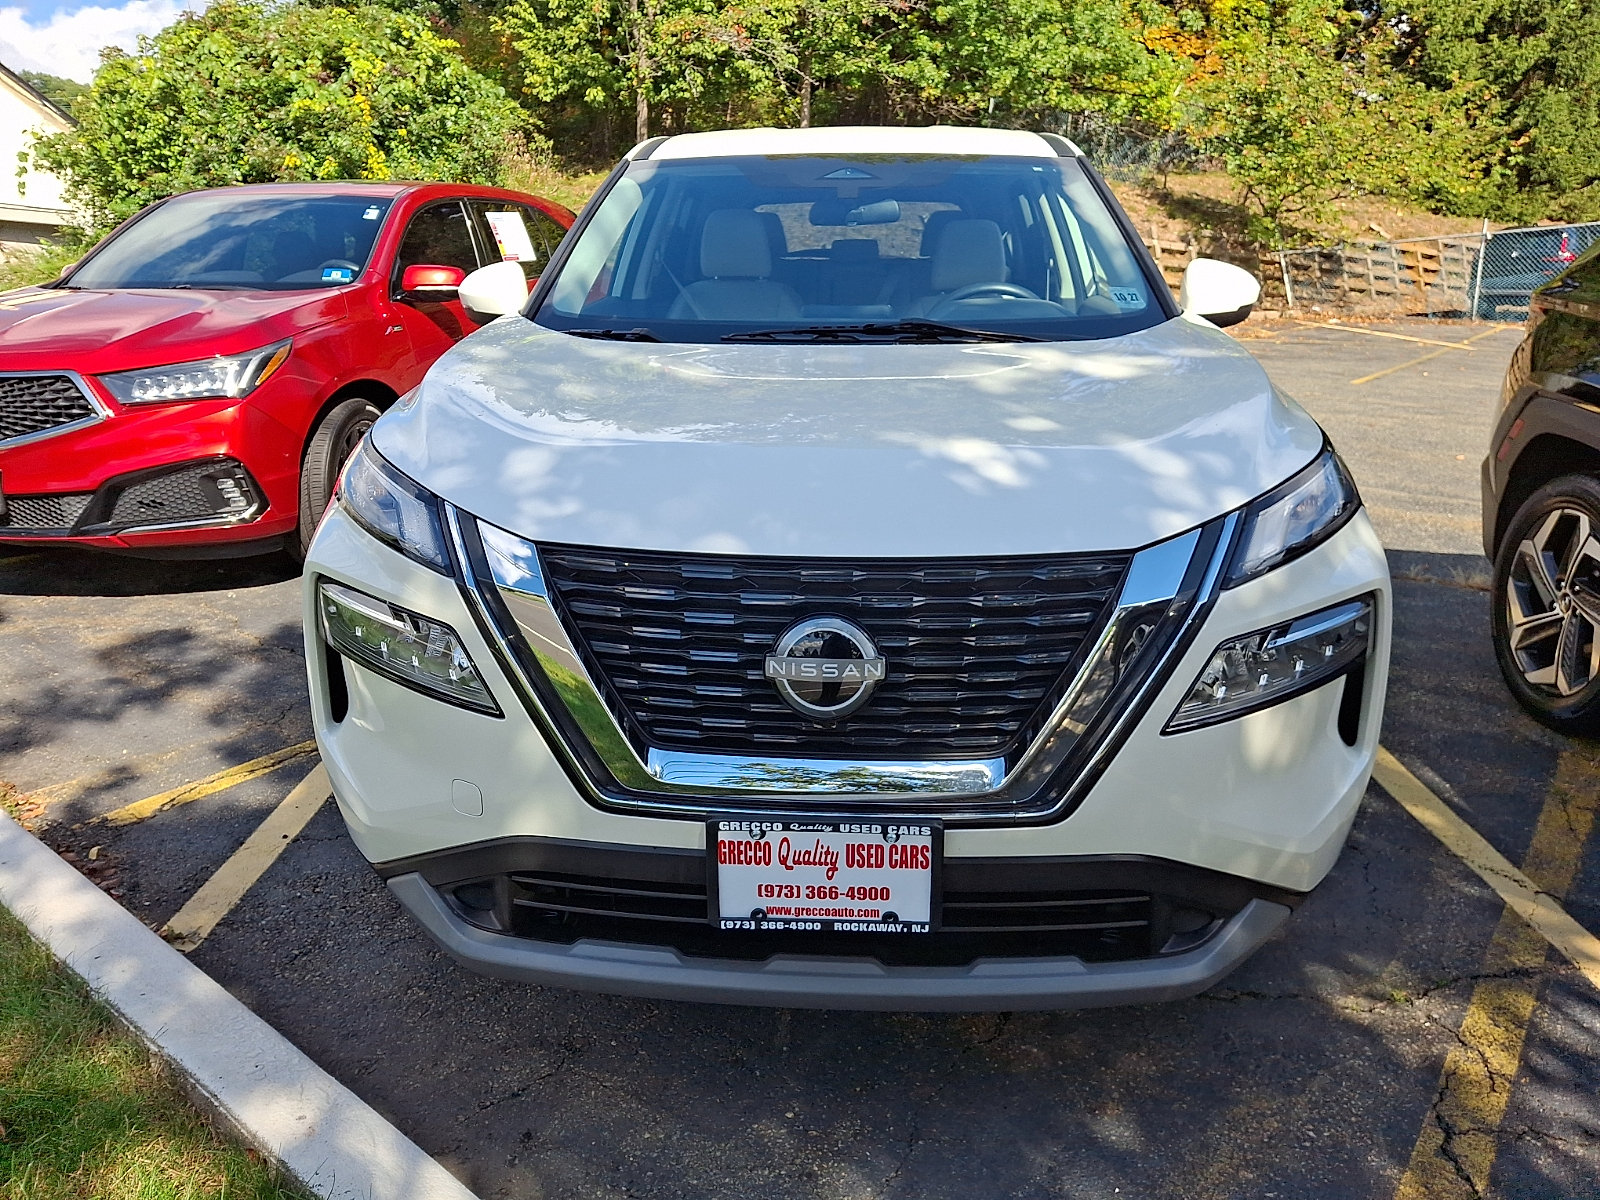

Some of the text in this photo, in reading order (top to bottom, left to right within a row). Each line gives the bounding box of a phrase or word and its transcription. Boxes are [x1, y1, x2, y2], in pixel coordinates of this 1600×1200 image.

[769, 660, 881, 677] NISSAN
[718, 821, 931, 836] GRECCO Quality USED CARS
[717, 836, 930, 880] GRECCO Quality USED CARS
[805, 885, 890, 900] 366-4900
[765, 905, 880, 918] www.greccoauto.com
[760, 921, 822, 930] 366-4900
[833, 922, 907, 932] ROCKAWAY,
[911, 923, 929, 933] NJ
